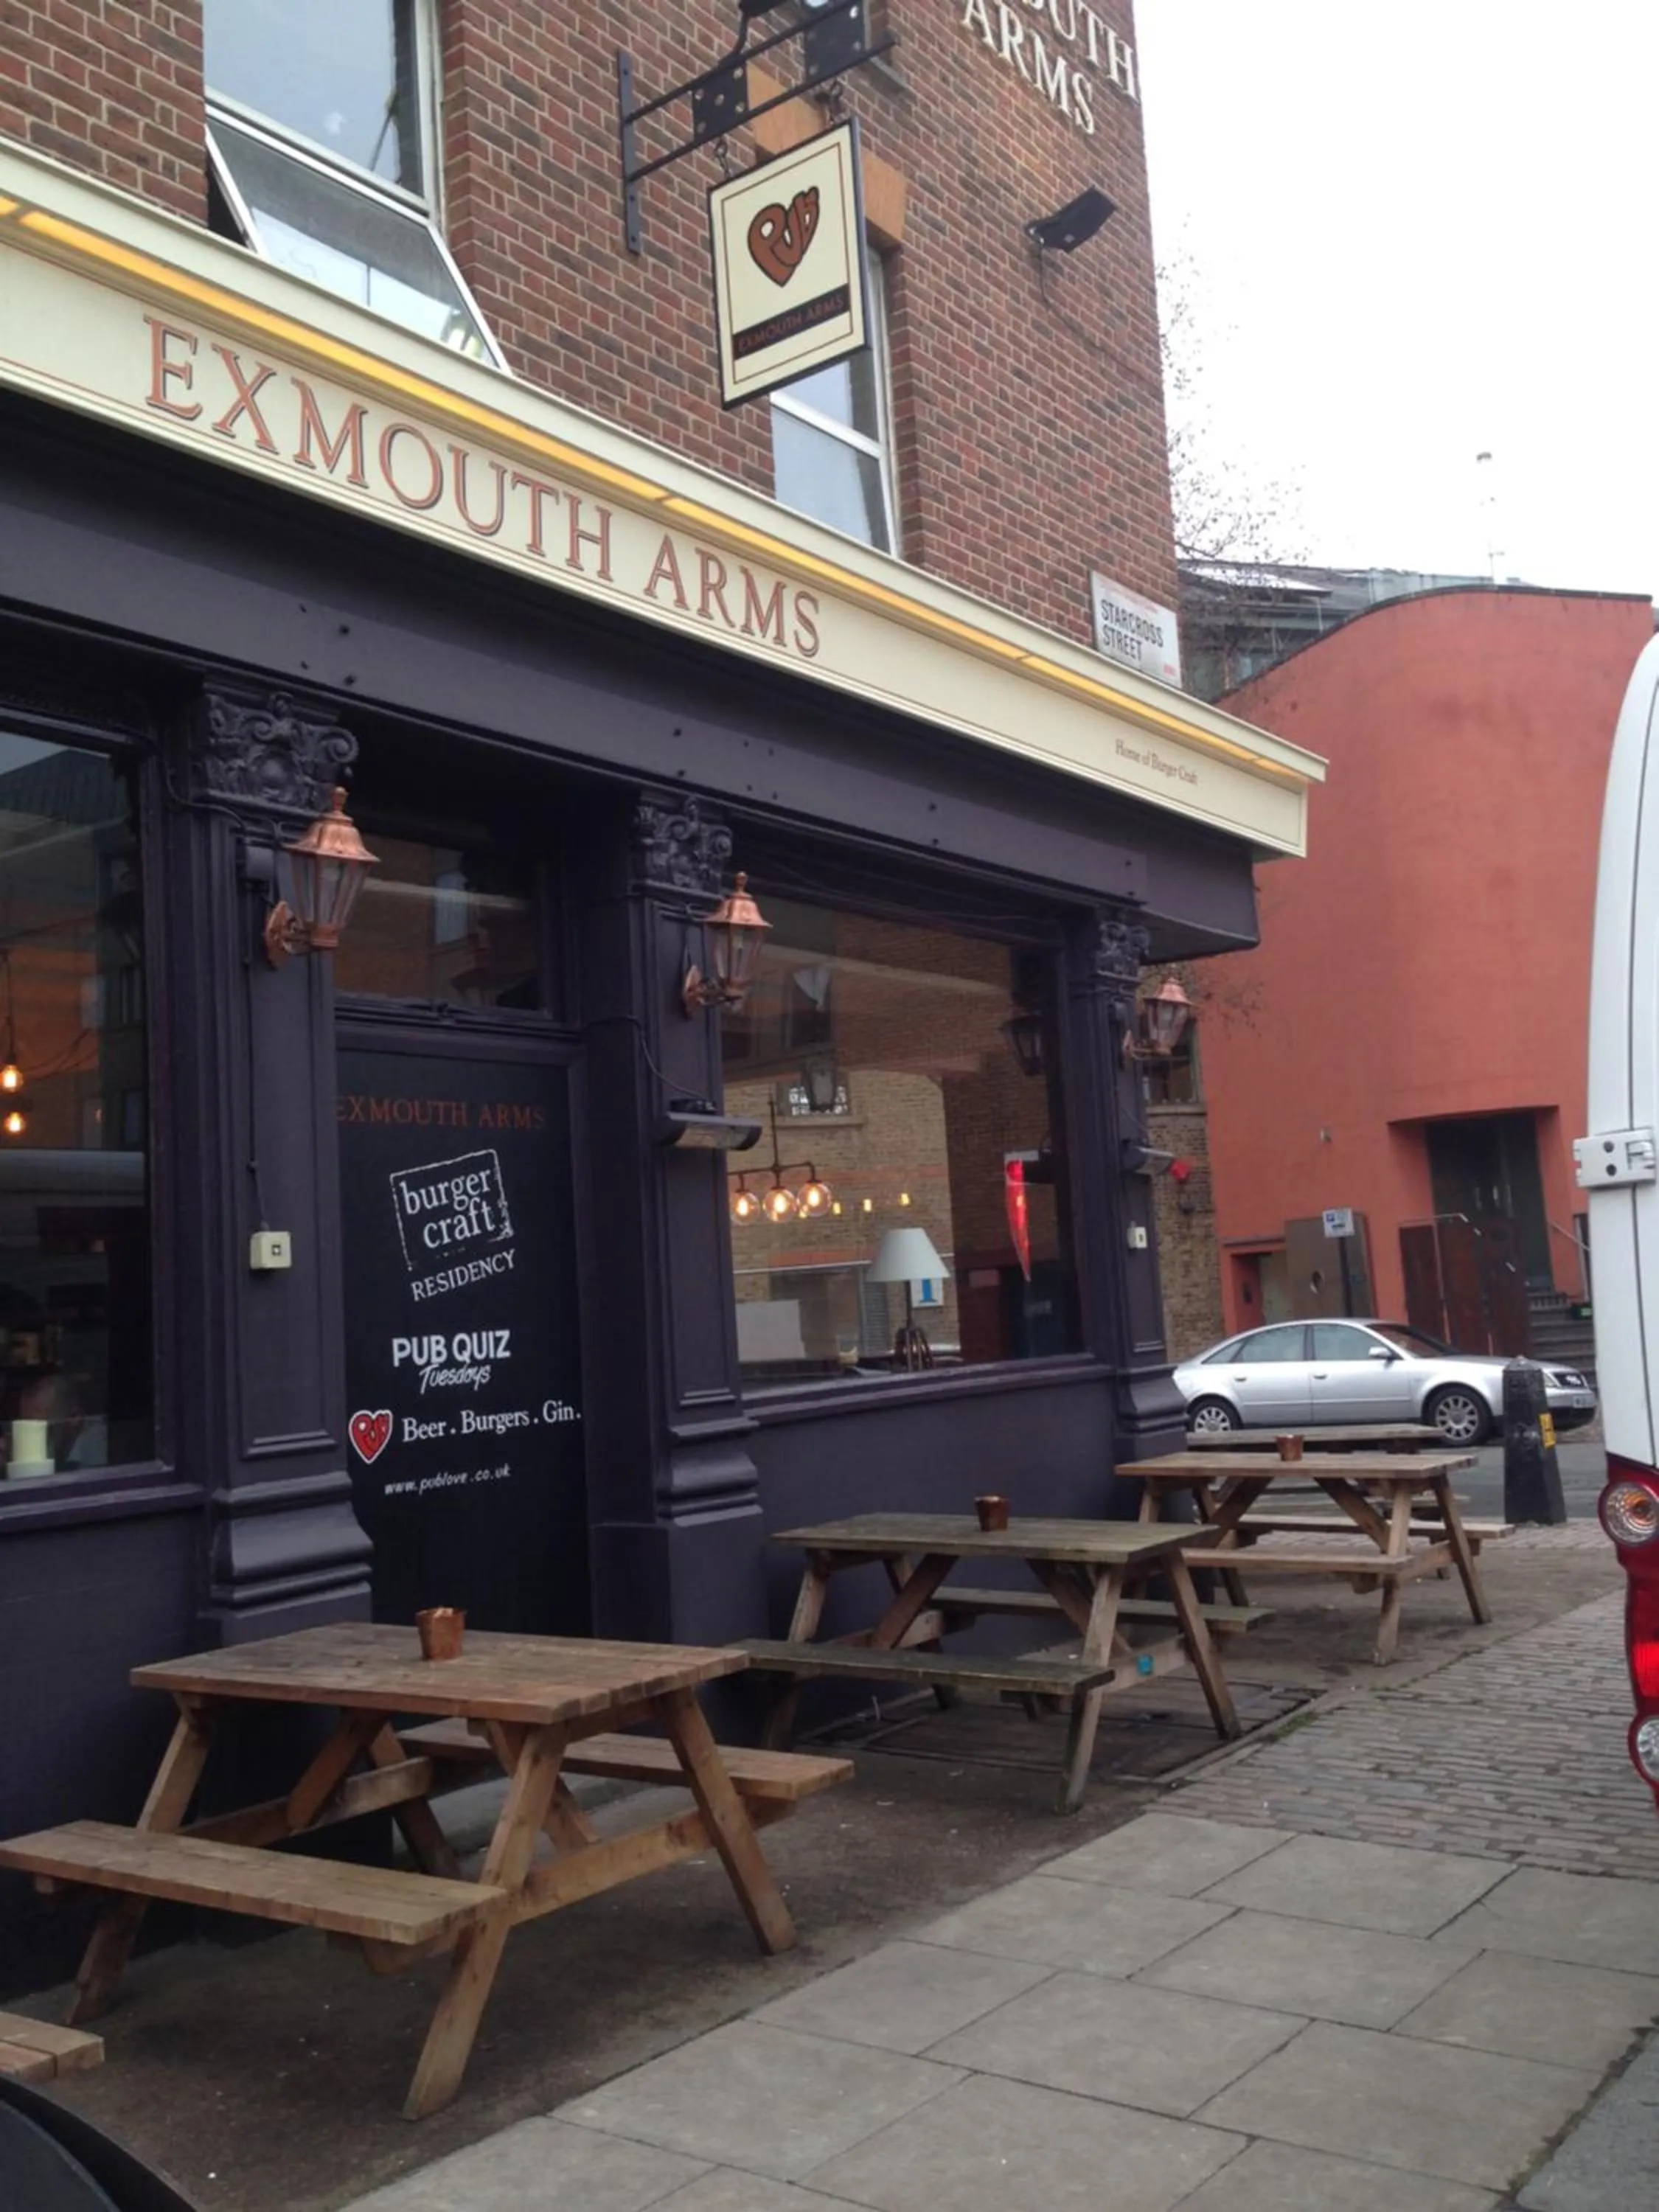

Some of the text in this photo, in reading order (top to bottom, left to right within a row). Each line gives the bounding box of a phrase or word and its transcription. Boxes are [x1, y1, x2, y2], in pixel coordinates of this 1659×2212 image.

[961, 0, 1094, 136] ARMS
[1022, 0, 1141, 106] UTH
[738, 294, 845, 352] EXMOUTH ARMS
[144, 313, 821, 657] EXMOUTH ARMS
[1101, 599, 1164, 647] STARCROSS
[1103, 624, 1142, 661] STREET
[334, 1095, 546, 1129] EXMOUTH ARMS
[400, 1169, 490, 1214] burger
[423, 1197, 495, 1248] craft
[411, 1248, 515, 1301] RESIDENCY
[392, 1329, 511, 1367] PUB QUIZ
[418, 1363, 491, 1395] Tuesdays
